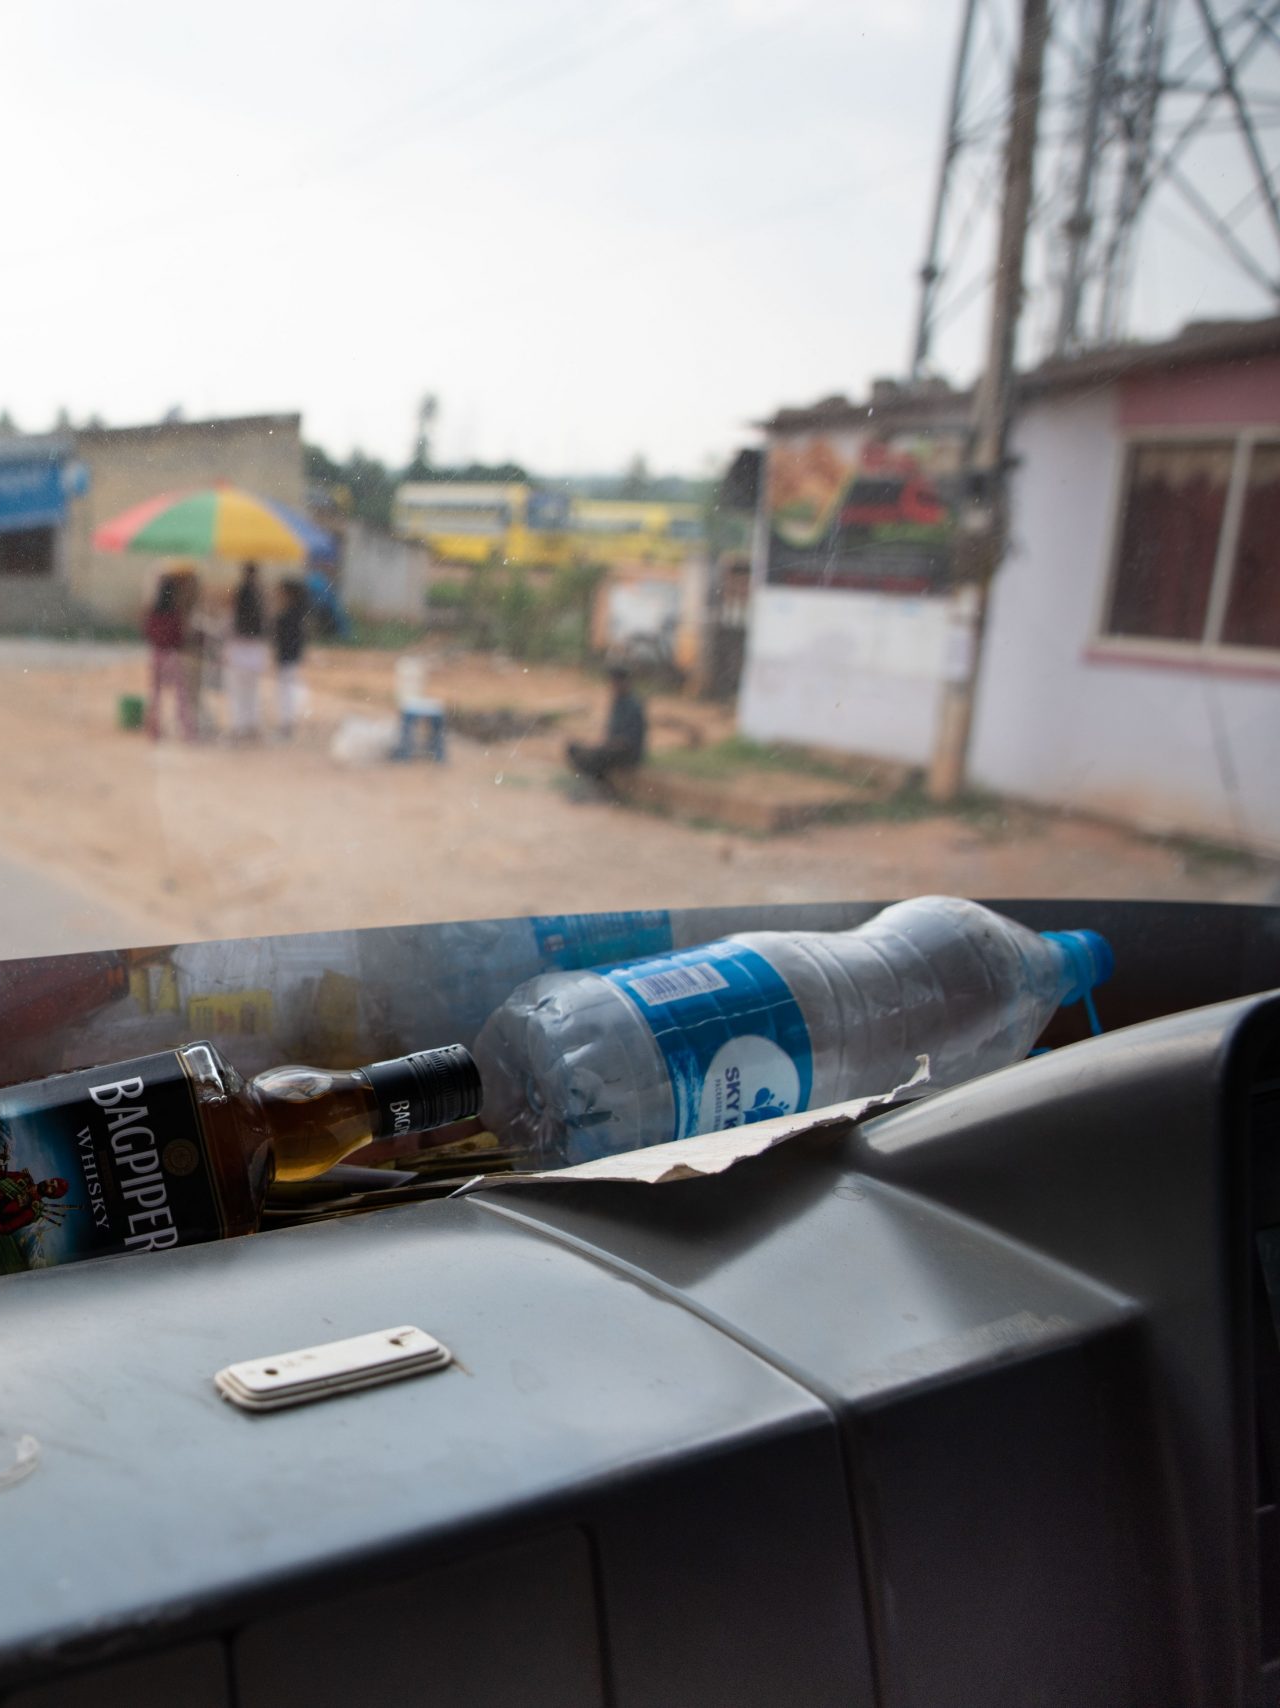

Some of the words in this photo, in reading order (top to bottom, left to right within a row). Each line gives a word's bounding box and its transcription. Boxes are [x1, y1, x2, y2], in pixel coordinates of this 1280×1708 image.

[724, 1066, 741, 1111] SKY
[76, 1125, 110, 1229] WHISKY
[88, 1076, 179, 1251] BAGPIPER
